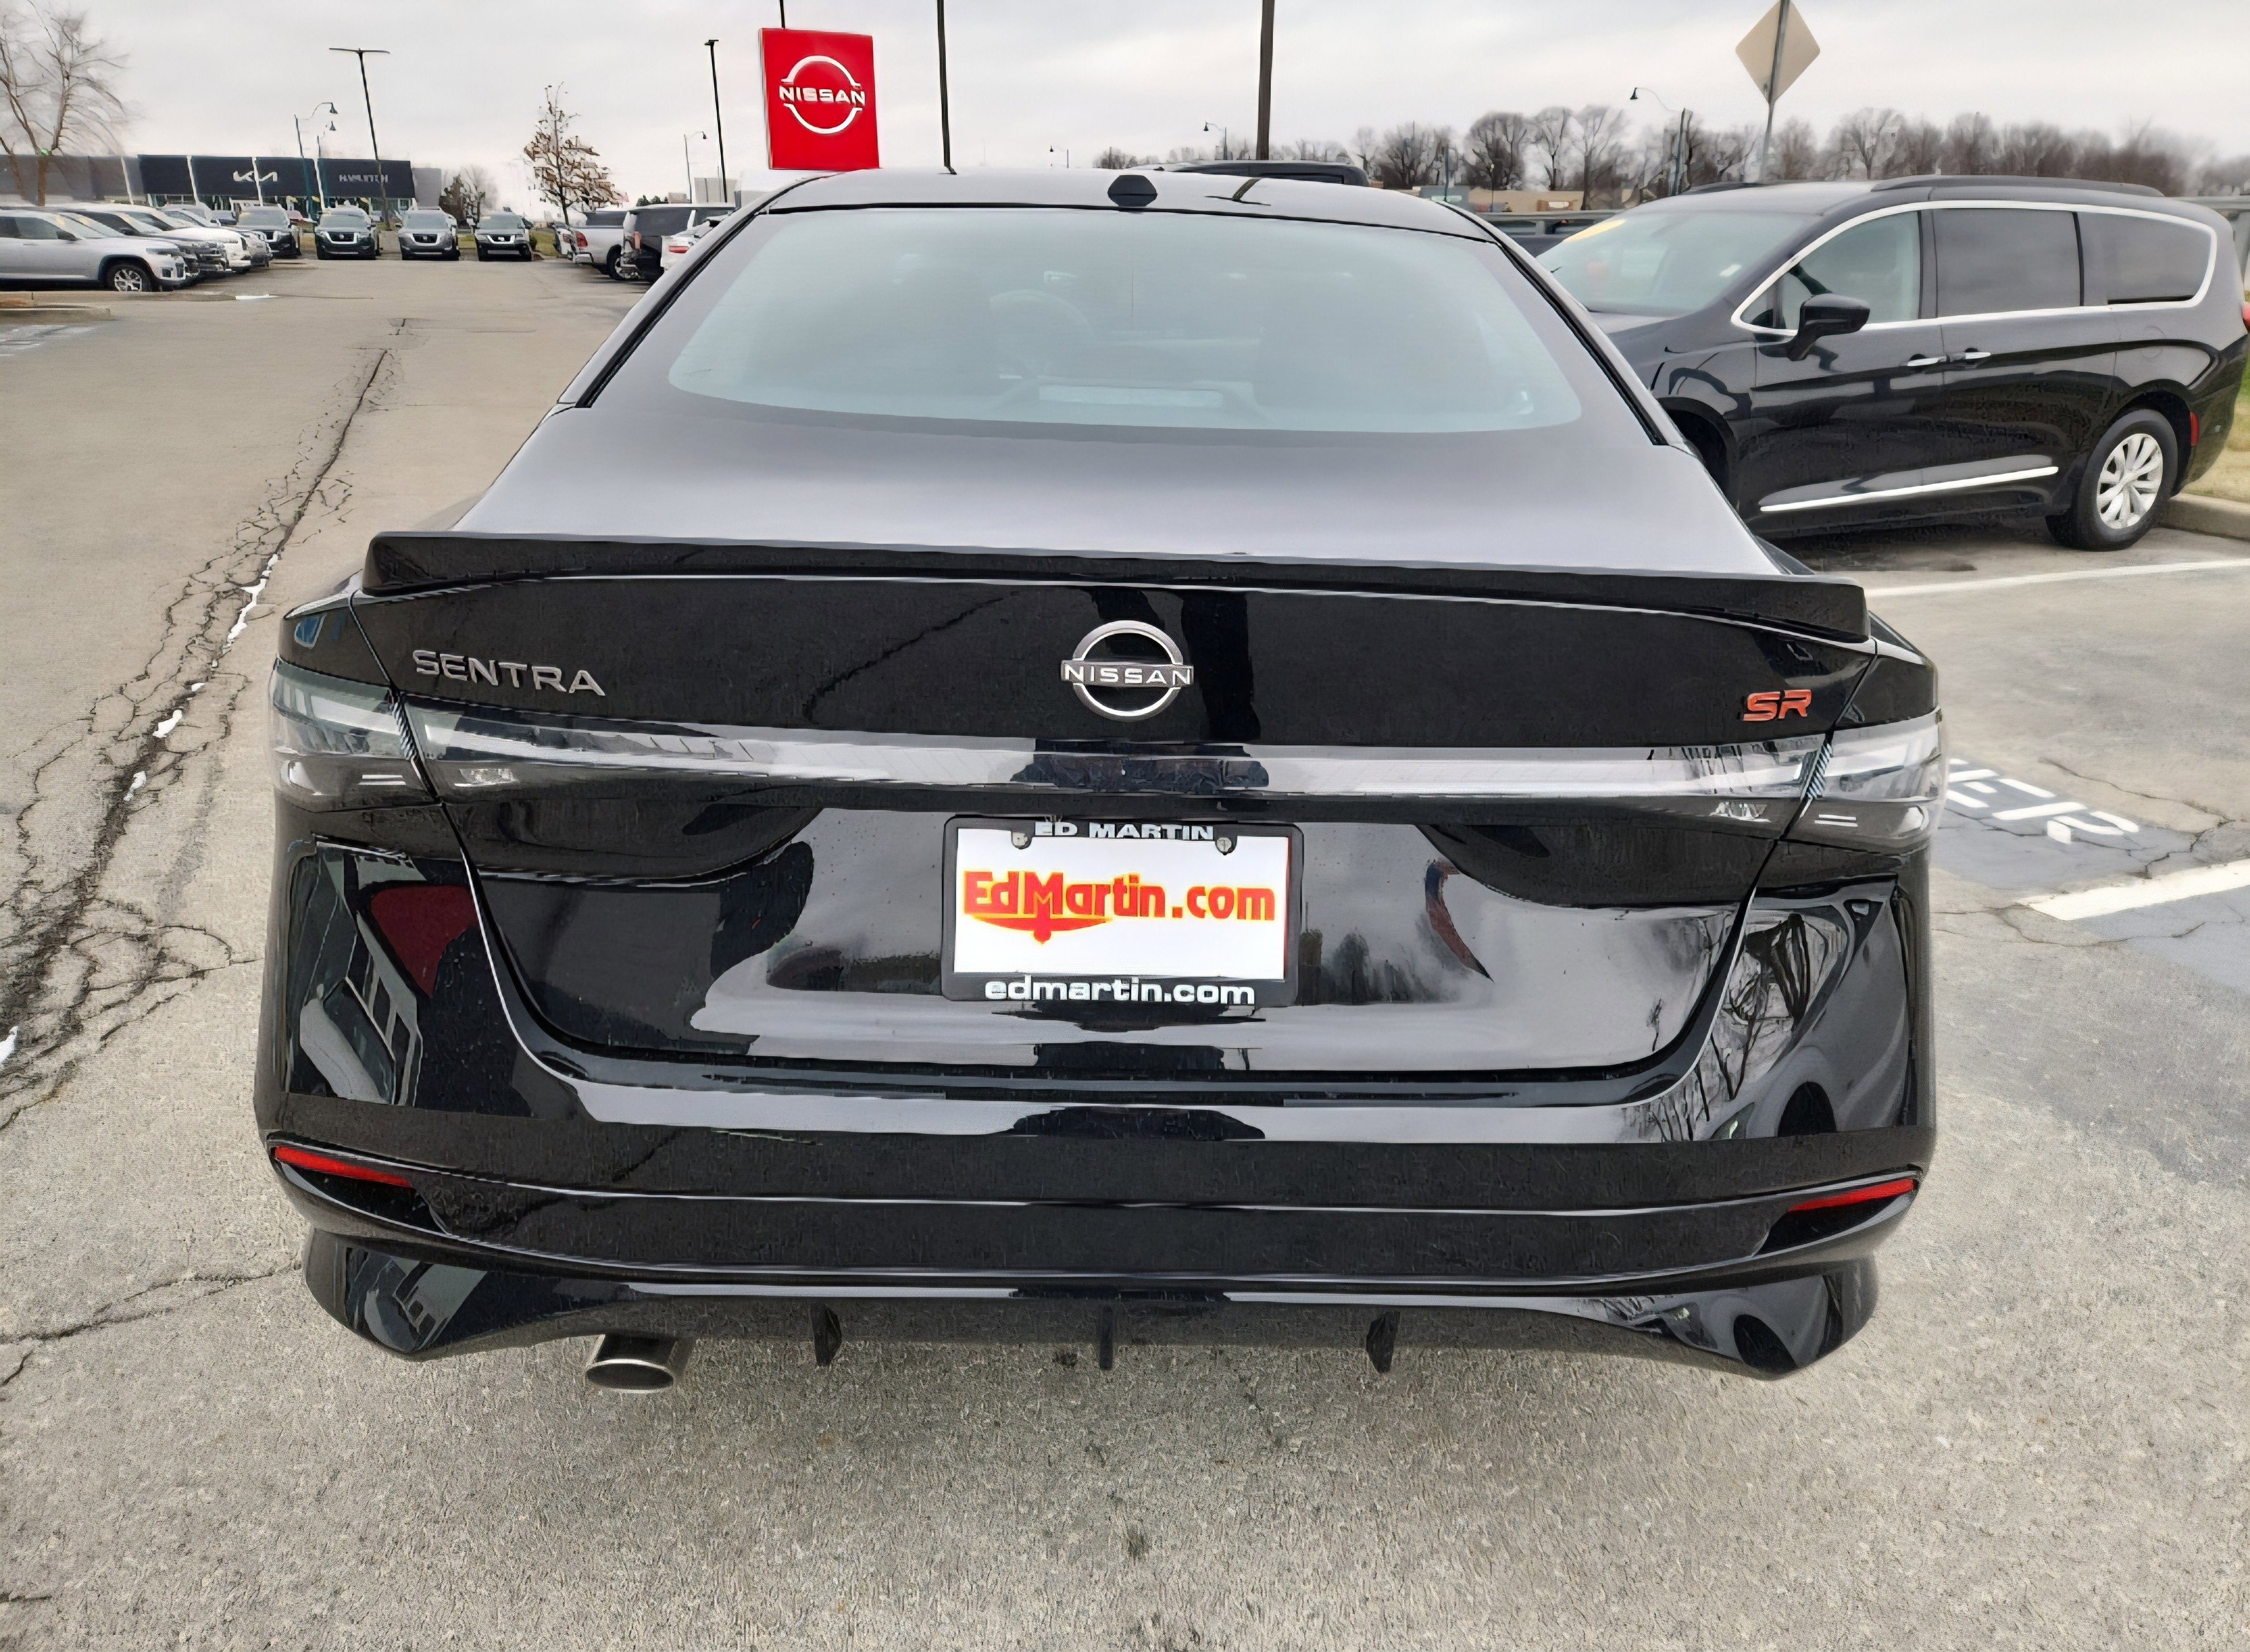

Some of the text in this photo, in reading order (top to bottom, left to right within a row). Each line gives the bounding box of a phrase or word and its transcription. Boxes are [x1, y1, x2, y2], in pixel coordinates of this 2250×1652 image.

[779, 85, 866, 106] NISSAN
[233, 170, 278, 182] KA
[413, 649, 606, 696] SENTRA
[1064, 663, 1191, 685] NISSAN
[1743, 689, 1812, 721] SR
[1035, 821, 1214, 841] ED MARTIN
[964, 870, 1276, 922] EdMartin.com
[984, 974, 1255, 1005] edmartin.com
